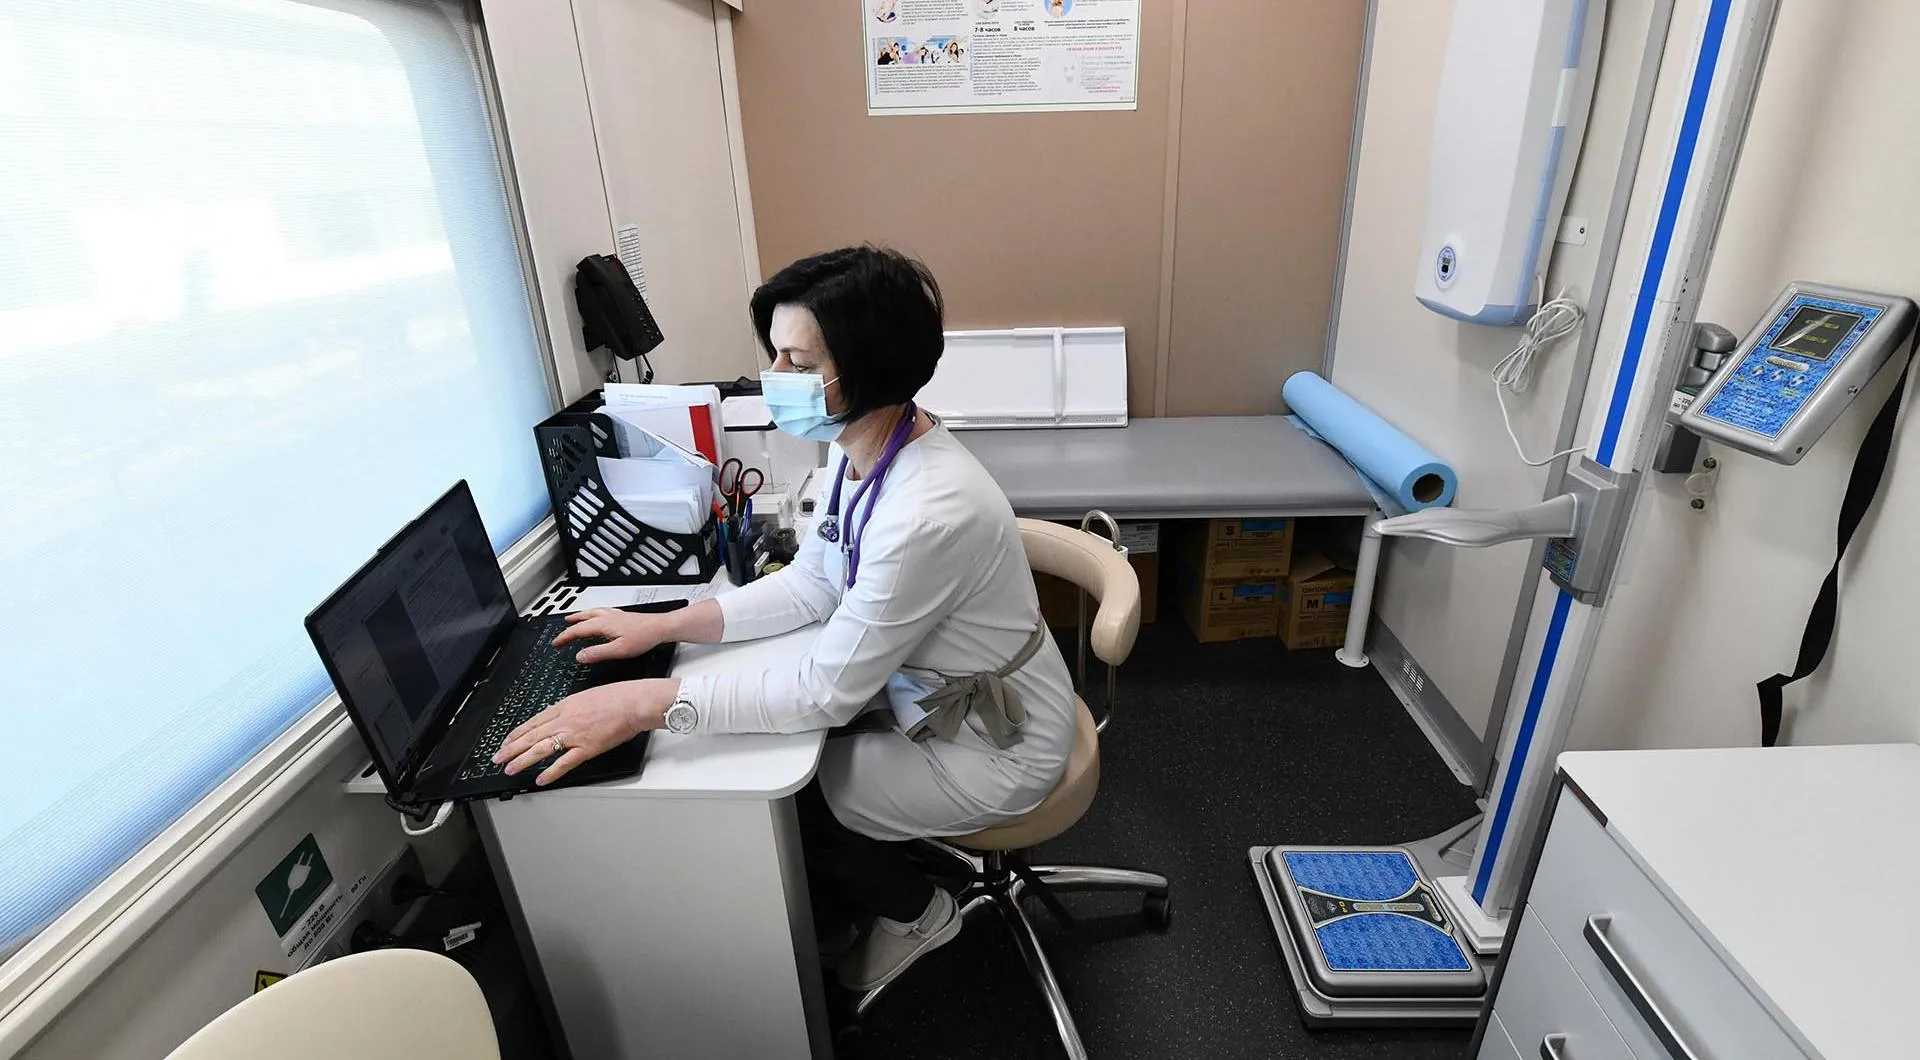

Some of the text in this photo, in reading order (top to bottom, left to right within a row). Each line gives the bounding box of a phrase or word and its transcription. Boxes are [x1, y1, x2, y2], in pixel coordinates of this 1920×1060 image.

[1226, 525, 1235, 536] S
[1219, 591, 1227, 601] L
[1306, 599, 1319, 609] M
